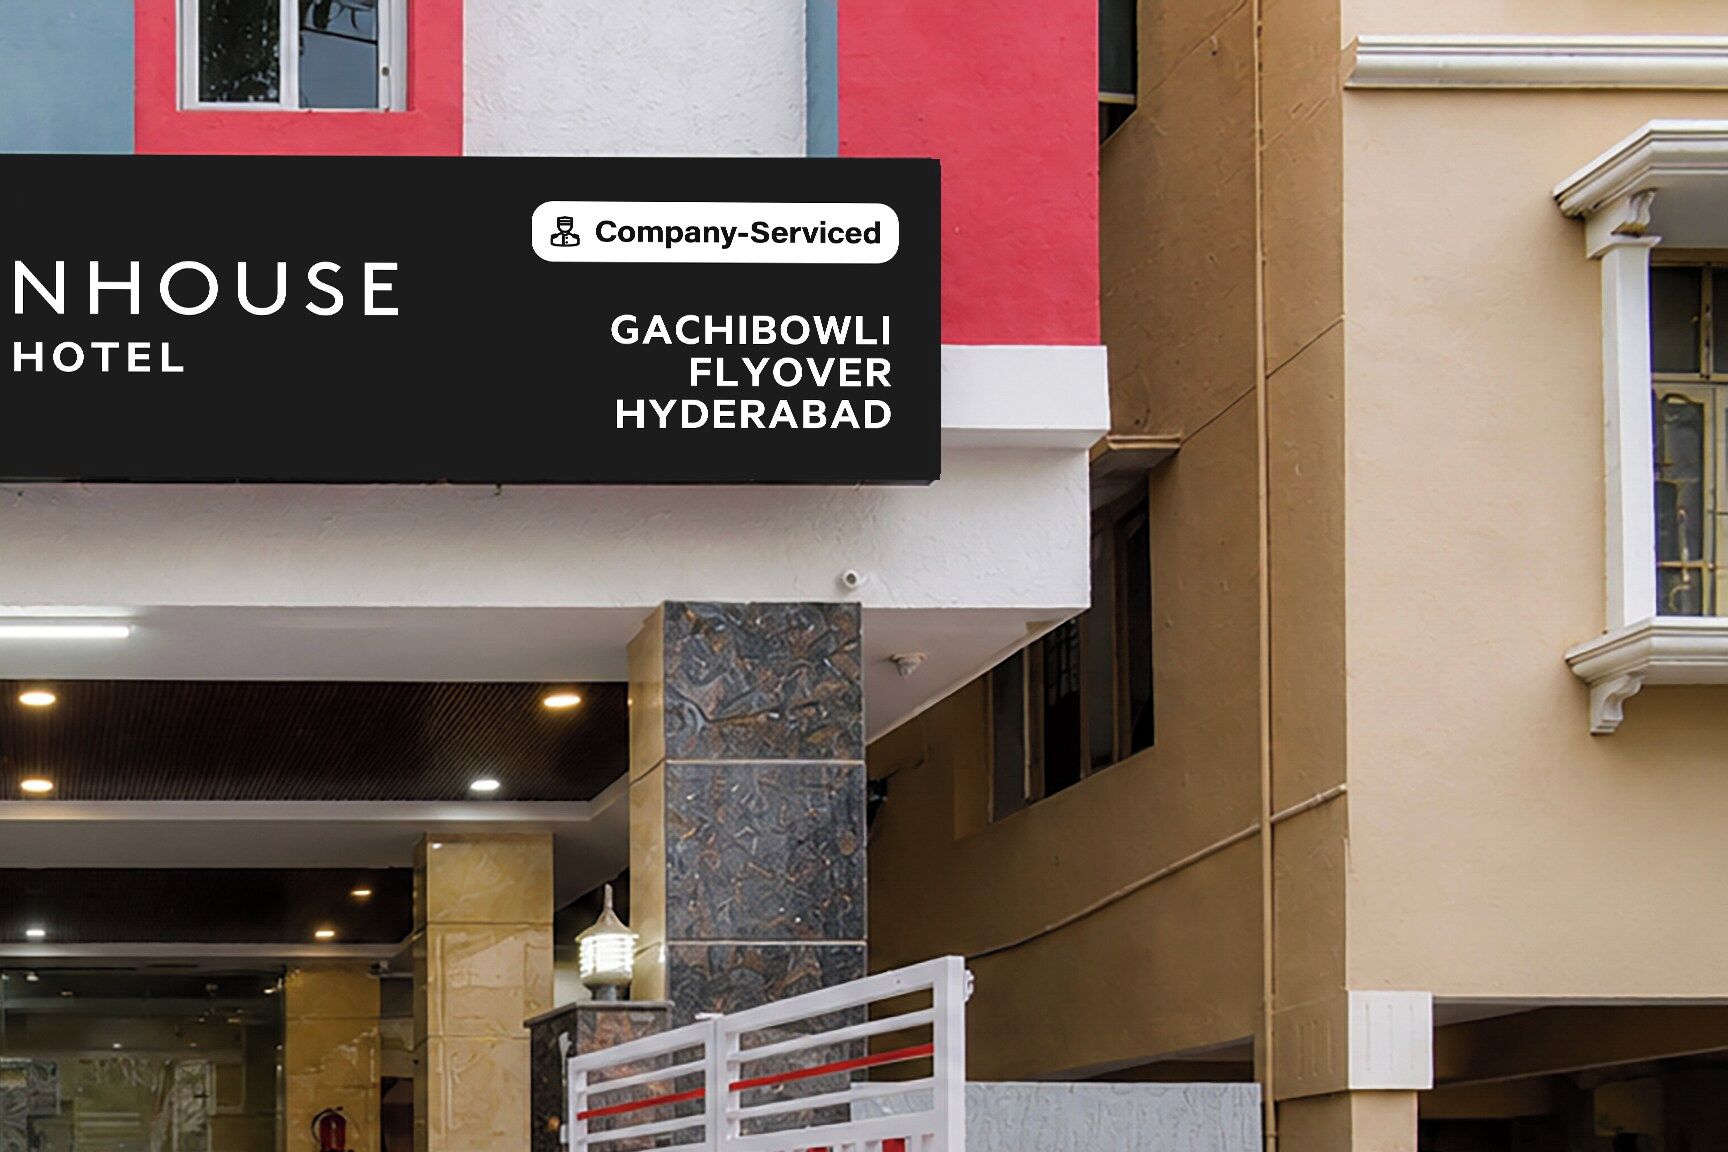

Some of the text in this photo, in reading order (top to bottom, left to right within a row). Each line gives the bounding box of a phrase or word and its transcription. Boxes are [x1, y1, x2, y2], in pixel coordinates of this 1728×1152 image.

[595, 220, 881, 250] Company-Serviced
[610, 314, 891, 346] GACHIBOWLI
[13, 341, 185, 373] HOTEL
[690, 356, 892, 388] FLYOVER
[616, 399, 892, 429] HYDERABAD
